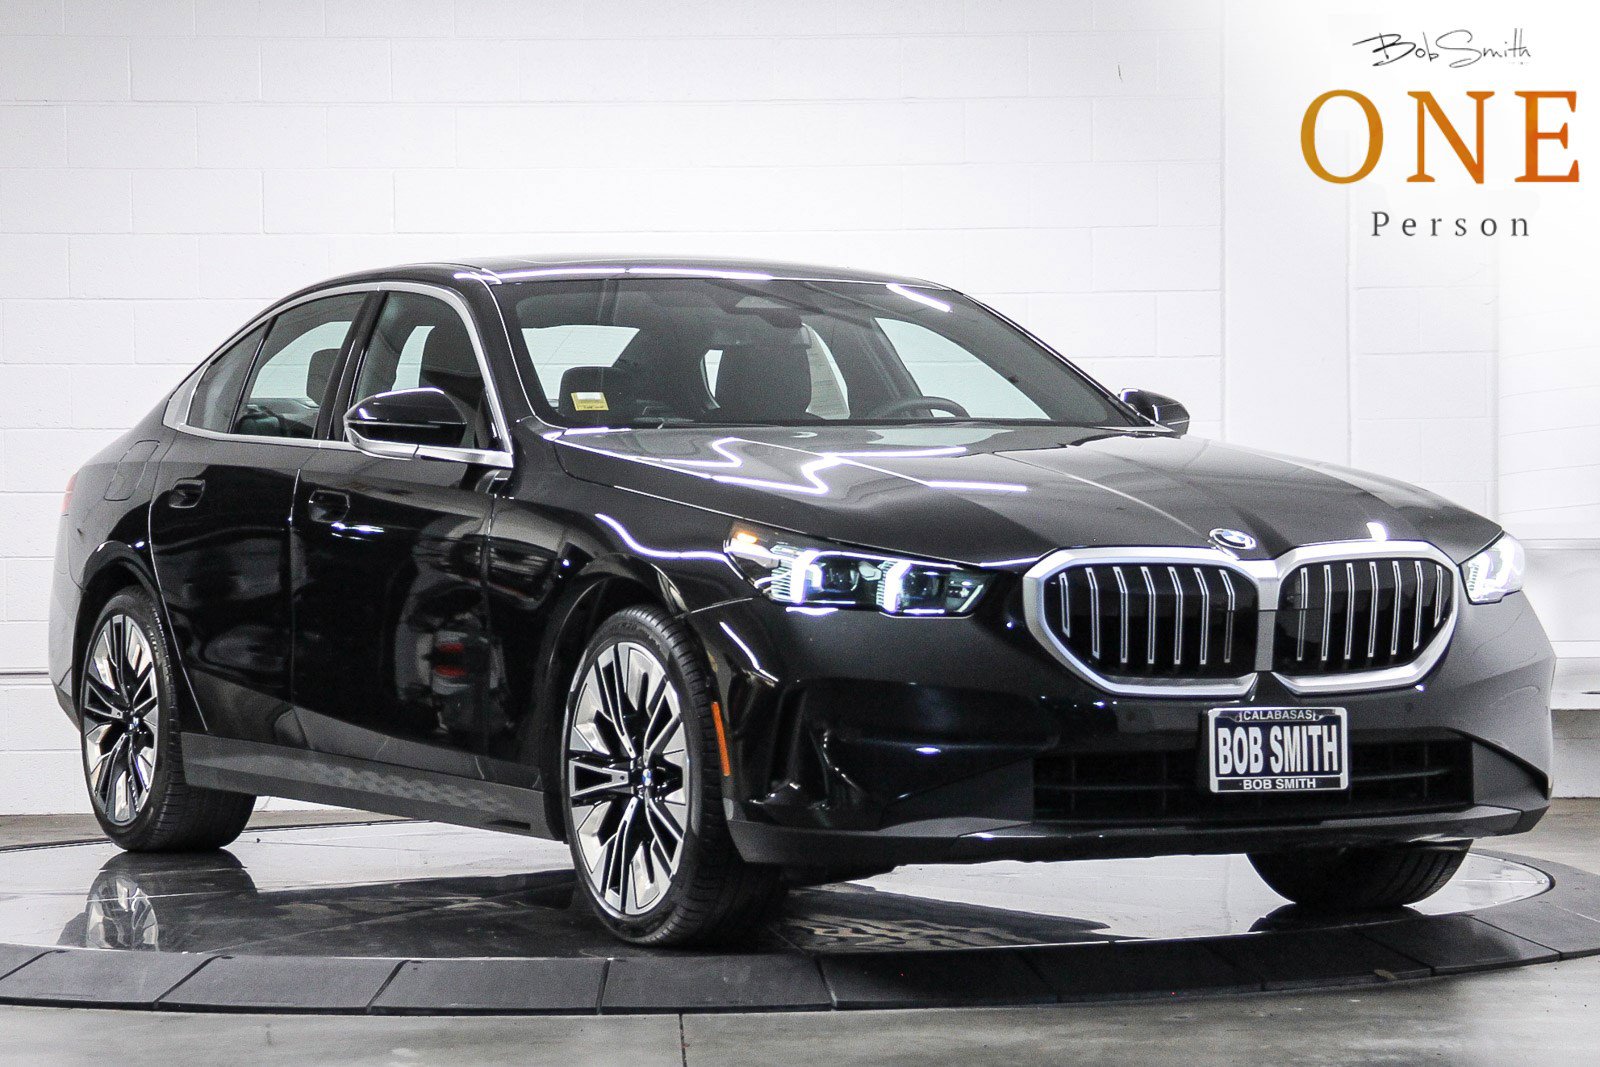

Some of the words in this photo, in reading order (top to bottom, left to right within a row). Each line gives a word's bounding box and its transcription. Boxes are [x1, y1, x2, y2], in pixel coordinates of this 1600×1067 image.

[1243, 710, 1313, 721] CALABASAS
[1217, 726, 1264, 775] BOB
[1269, 725, 1338, 774] SMITH
[1243, 779, 1272, 790] BOB
[1275, 778, 1316, 789] SMITH
